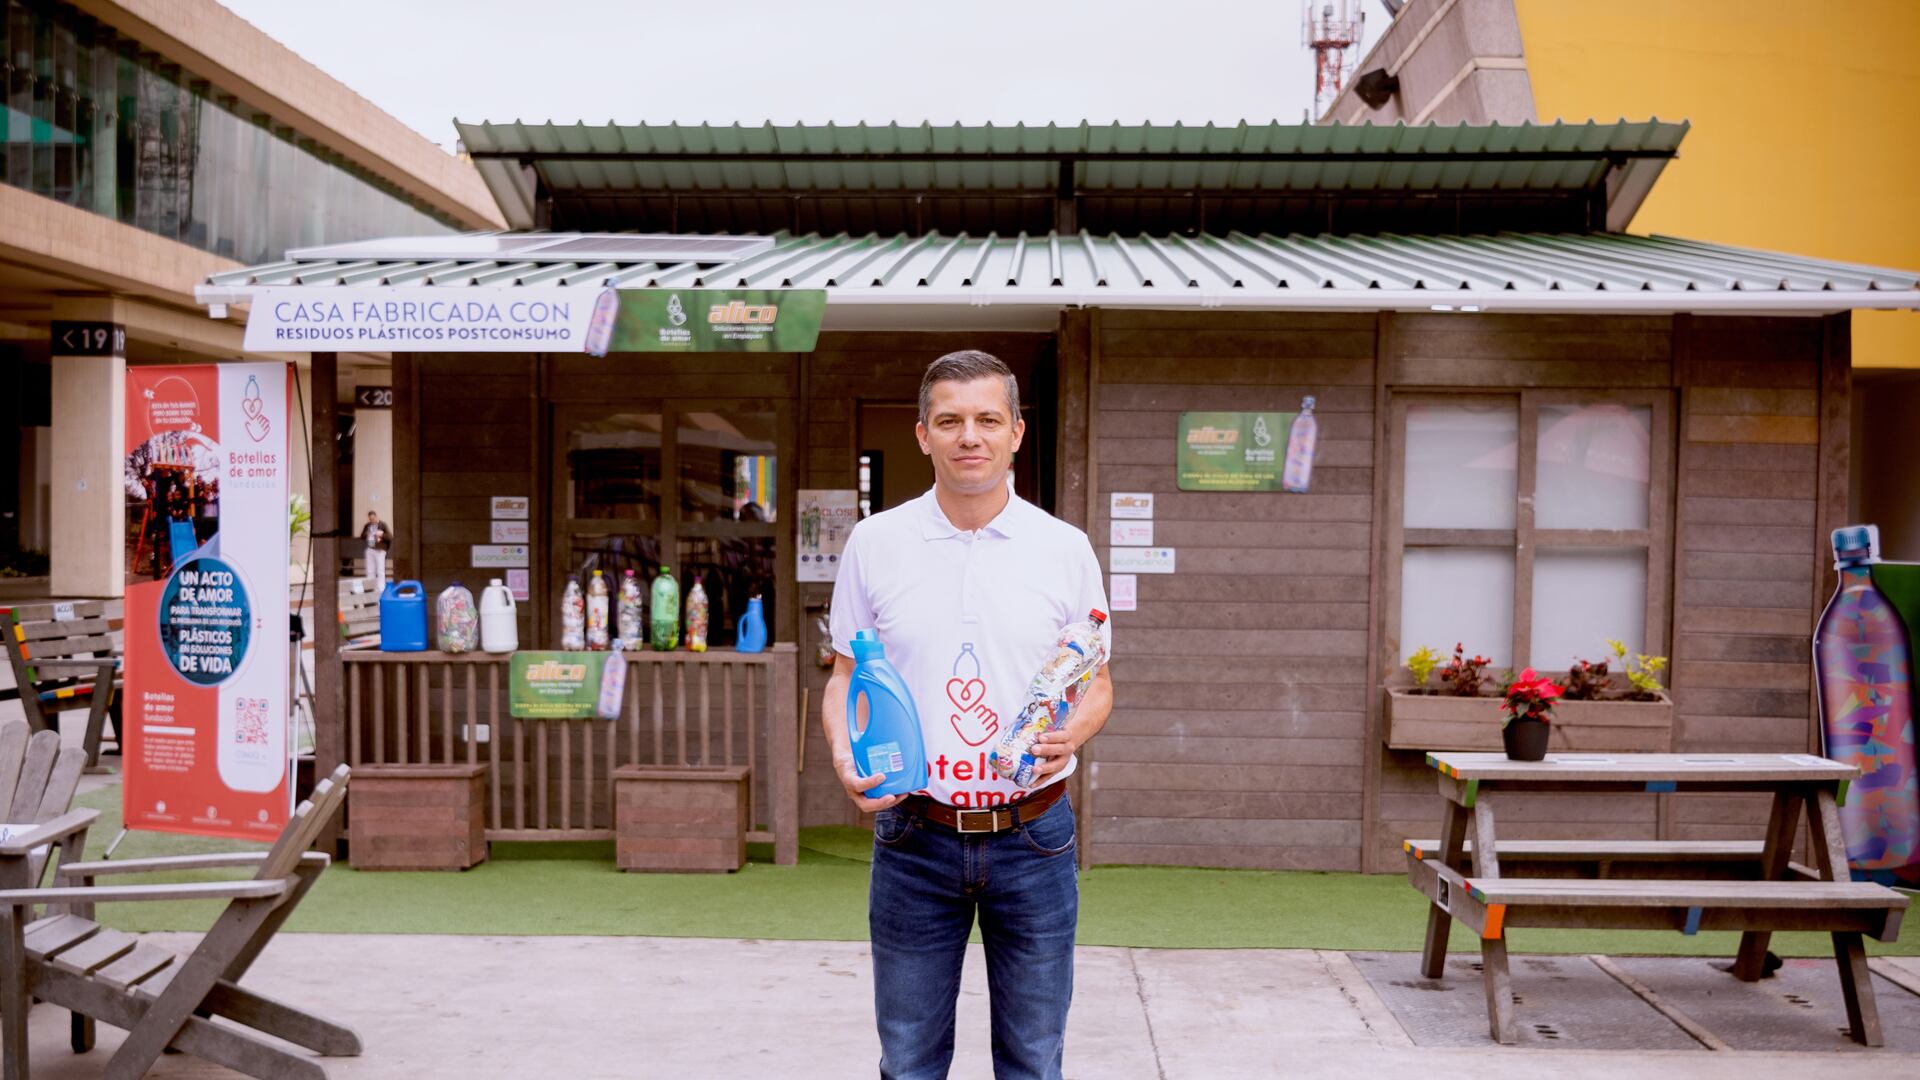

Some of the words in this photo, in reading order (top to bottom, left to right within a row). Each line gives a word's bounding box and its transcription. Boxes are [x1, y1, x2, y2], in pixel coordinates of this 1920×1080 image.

[275, 302, 344, 323] CASA
[353, 302, 502, 323] FABRICADA
[510, 302, 569, 323] CON
[708, 301, 778, 324] alico
[82, 328, 107, 349] 19
[276, 328, 354, 340] RESIDUOS
[359, 324, 443, 340] PLÁSTICOS
[448, 328, 571, 340] POSTCONSUMO
[229, 452, 277, 464] Botellas
[230, 466, 244, 477] de
[248, 468, 277, 477] amor
[180, 571, 199, 585] UN
[200, 571, 233, 586] ACTO
[180, 588, 195, 601] DE
[197, 588, 233, 602] AMOR
[170, 606, 190, 615] PARA
[191, 606, 242, 616] TRANSFORMAR
[180, 627, 232, 643] PLÁSTICOS
[180, 645, 189, 653] EN
[190, 645, 232, 655] SOLUCIONES
[180, 656, 197, 672] DE
[200, 657, 232, 673] VIDA
